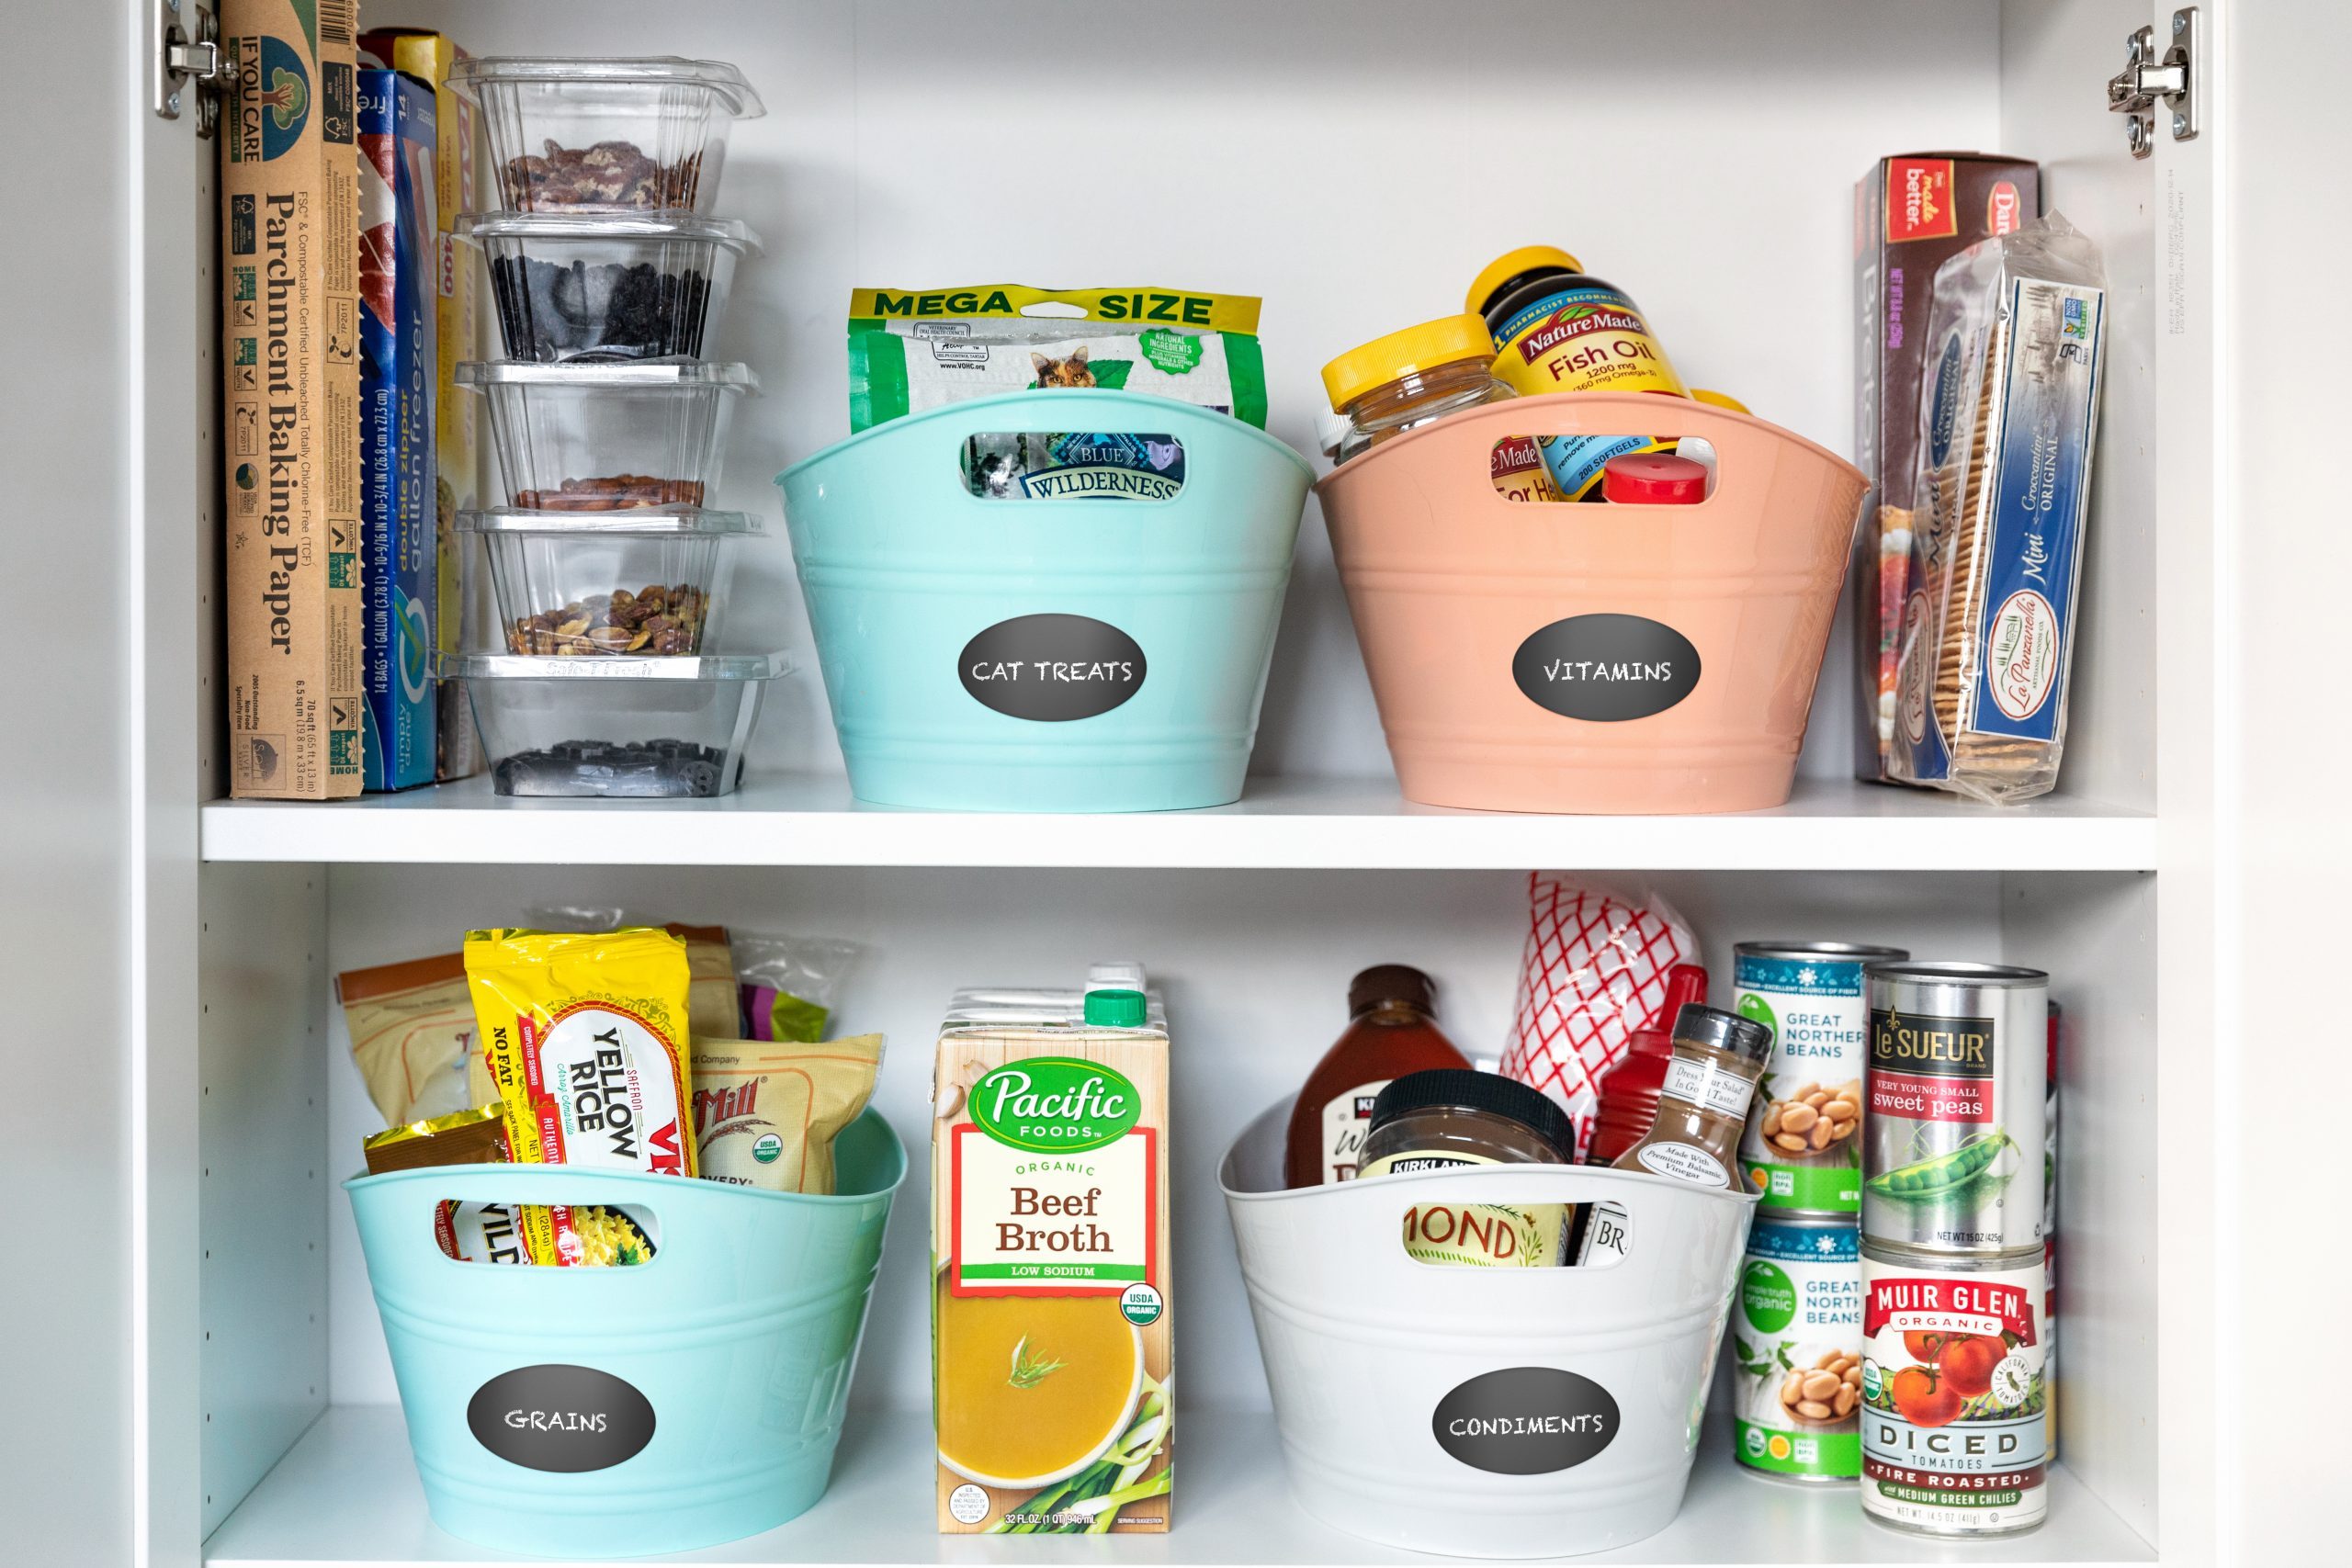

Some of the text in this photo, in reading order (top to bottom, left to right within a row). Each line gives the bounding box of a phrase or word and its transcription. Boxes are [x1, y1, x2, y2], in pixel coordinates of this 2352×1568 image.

[242, 36, 260, 163] IF YOU CARE
[1906, 168, 1925, 227] better
[1922, 175, 1939, 223] made
[1890, 268, 1903, 283] NET
[874, 290, 1214, 325] MEGA SIZE
[1505, 299, 1563, 337] PHARMACIST
[1149, 338, 1193, 355] INGREDIENTS
[1155, 332, 1185, 344] NATURAL
[940, 363, 986, 371] www.VOHC.org
[1548, 340, 1657, 382] Fish Oil
[1586, 362, 1636, 379] 1200 mg
[297, 222, 311, 567] & Compostable Certified Unbleached Totally Chlorine-Free (TCF)
[1595, 376, 1611, 385] mg
[262, 191, 299, 655] Parchment Baking Paper
[410, 310, 423, 572] gallon freezer
[1080, 447, 1125, 463] BLUE
[1557, 441, 1586, 470] remove
[1578, 437, 1641, 480] 200 SOFTGELS
[2021, 434, 2043, 511] Croccantini
[400, 389, 410, 571] double zipper
[1031, 471, 1176, 500] WILDERNESS
[2040, 436, 2059, 511] ORIGINAL
[373, 389, 390, 694] 14 BAGS GALLON (3.78 L) 10-9/16 IN 10-3/4 IN (26.8 cm 27.3 cm)
[2021, 532, 2049, 585] Mini
[1544, 658, 1672, 682] VITAMINS
[2008, 599, 2036, 712] La Panzanella
[972, 661, 1133, 682] CAT TREATS
[234, 685, 243, 715] Specialty
[251, 691, 259, 730] Outstanding
[295, 680, 306, 793] 6.5 sq (19.8 33 cm)
[304, 700, 316, 793] 70 sq (65 13 in)
[398, 703, 406, 773] simply
[330, 766, 358, 775] HOME
[1787, 1013, 1842, 1026] GREAT
[492, 1027, 514, 1087] NO FAT
[523, 1026, 538, 1086] COMPLETELY SEASONED
[1786, 1044, 1842, 1058] BEANS
[1874, 1023, 1984, 1063] Le SUEUR
[701, 1055, 741, 1066] Company
[594, 1027, 638, 1159] YELLOW
[627, 1069, 643, 1111] SAFFRON
[1675, 1078, 1737, 1106] In Taste!
[1677, 1066, 1743, 1095] Dress Salad
[1876, 1079, 1979, 1098] VERY YOUNG SMALL
[557, 1063, 575, 1135] Arroz Amarillo
[570, 1060, 605, 1133] RICE
[692, 1077, 759, 1137] Mill
[985, 1070, 1127, 1123] Pacific
[1873, 1092, 1984, 1118] sweet peas
[543, 1118, 560, 1164] AUTHENTI
[1020, 1126, 1092, 1137] FOODS
[528, 1139, 540, 1158] NET
[1665, 1147, 1710, 1167] Made With
[1015, 1161, 1095, 1176] ORGANIC
[1646, 1150, 1723, 1180] Premium Balsamic
[1666, 1162, 1701, 1179] Vinegar
[1010, 1187, 1102, 1216] Beef
[537, 1215, 551, 1247] (284g)
[995, 1223, 1114, 1252] Broth
[1937, 1231, 2004, 1244] NET WT 15 OZ (425g)
[1012, 1266, 1095, 1277] LOW SODIUM
[1129, 1293, 1154, 1303] USDA
[1806, 1280, 1859, 1293] GREAT
[1126, 1305, 1157, 1315] ORGANIC
[1877, 1285, 2018, 1318] MUIR GLEN
[1899, 1317, 1993, 1331] ORGANIC
[1996, 1358, 2029, 1381] CALIFORNIA
[1996, 1383, 2029, 1404] TOMATOES
[504, 1409, 607, 1433] GRAINS
[1449, 1414, 1603, 1437] CONDIMENTS
[1880, 1424, 2018, 1455] DICED
[1876, 1464, 2021, 1487] FIRE ROASTED
[1912, 1455, 1983, 1470] TOMATOES
[1897, 1487, 2017, 1505] MEDIUM GREEN CHILIES
[1005, 1514, 1015, 1524] 32
[1067, 1514, 1082, 1524] 946
[1896, 1506, 1909, 1516] NET
